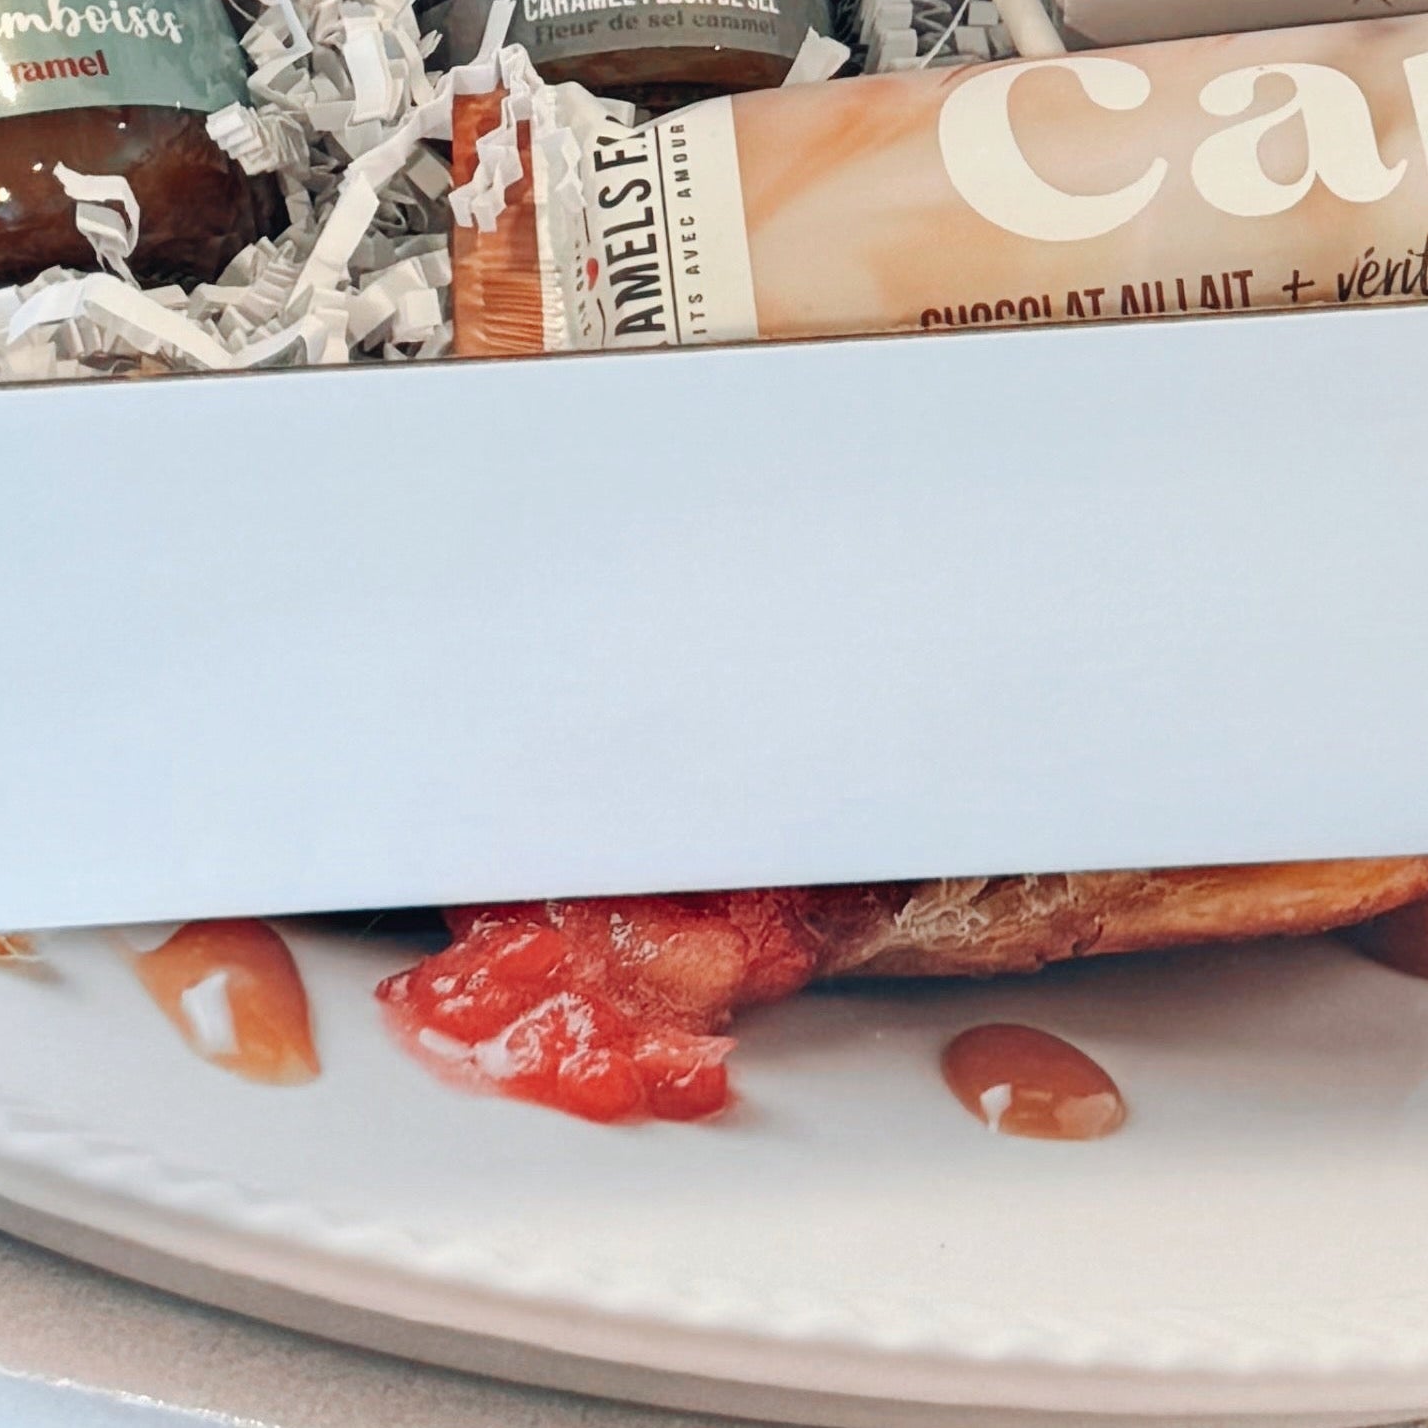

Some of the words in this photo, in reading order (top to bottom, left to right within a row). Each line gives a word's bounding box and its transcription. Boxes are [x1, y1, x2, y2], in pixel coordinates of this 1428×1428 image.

[608, 12, 639, 31] de
[648, 10, 685, 27] sel
[670, 123, 693, 199] AMOUR
[598, 178, 666, 340] AMELS
[679, 215, 701, 276] AVEC
[1282, 269, 1315, 303] +
